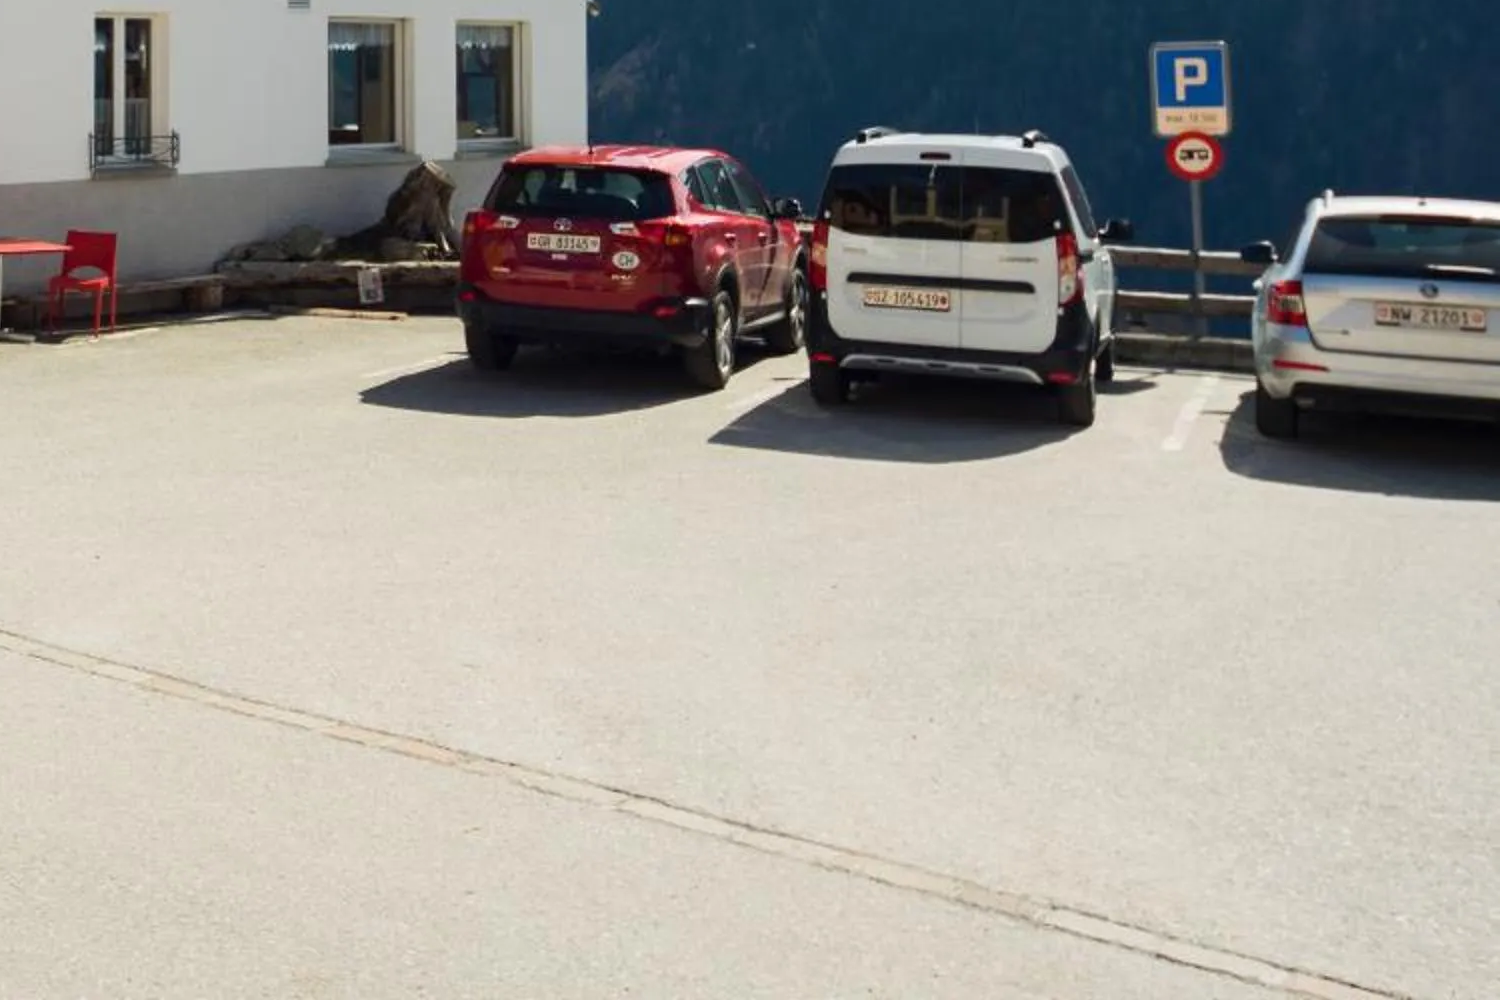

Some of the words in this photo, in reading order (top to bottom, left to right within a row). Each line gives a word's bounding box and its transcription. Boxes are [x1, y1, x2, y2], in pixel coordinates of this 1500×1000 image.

[1174, 57, 1208, 102] P
[617, 254, 636, 267] CH
[1390, 304, 1411, 320] NW
[1421, 308, 1469, 325] 21201
